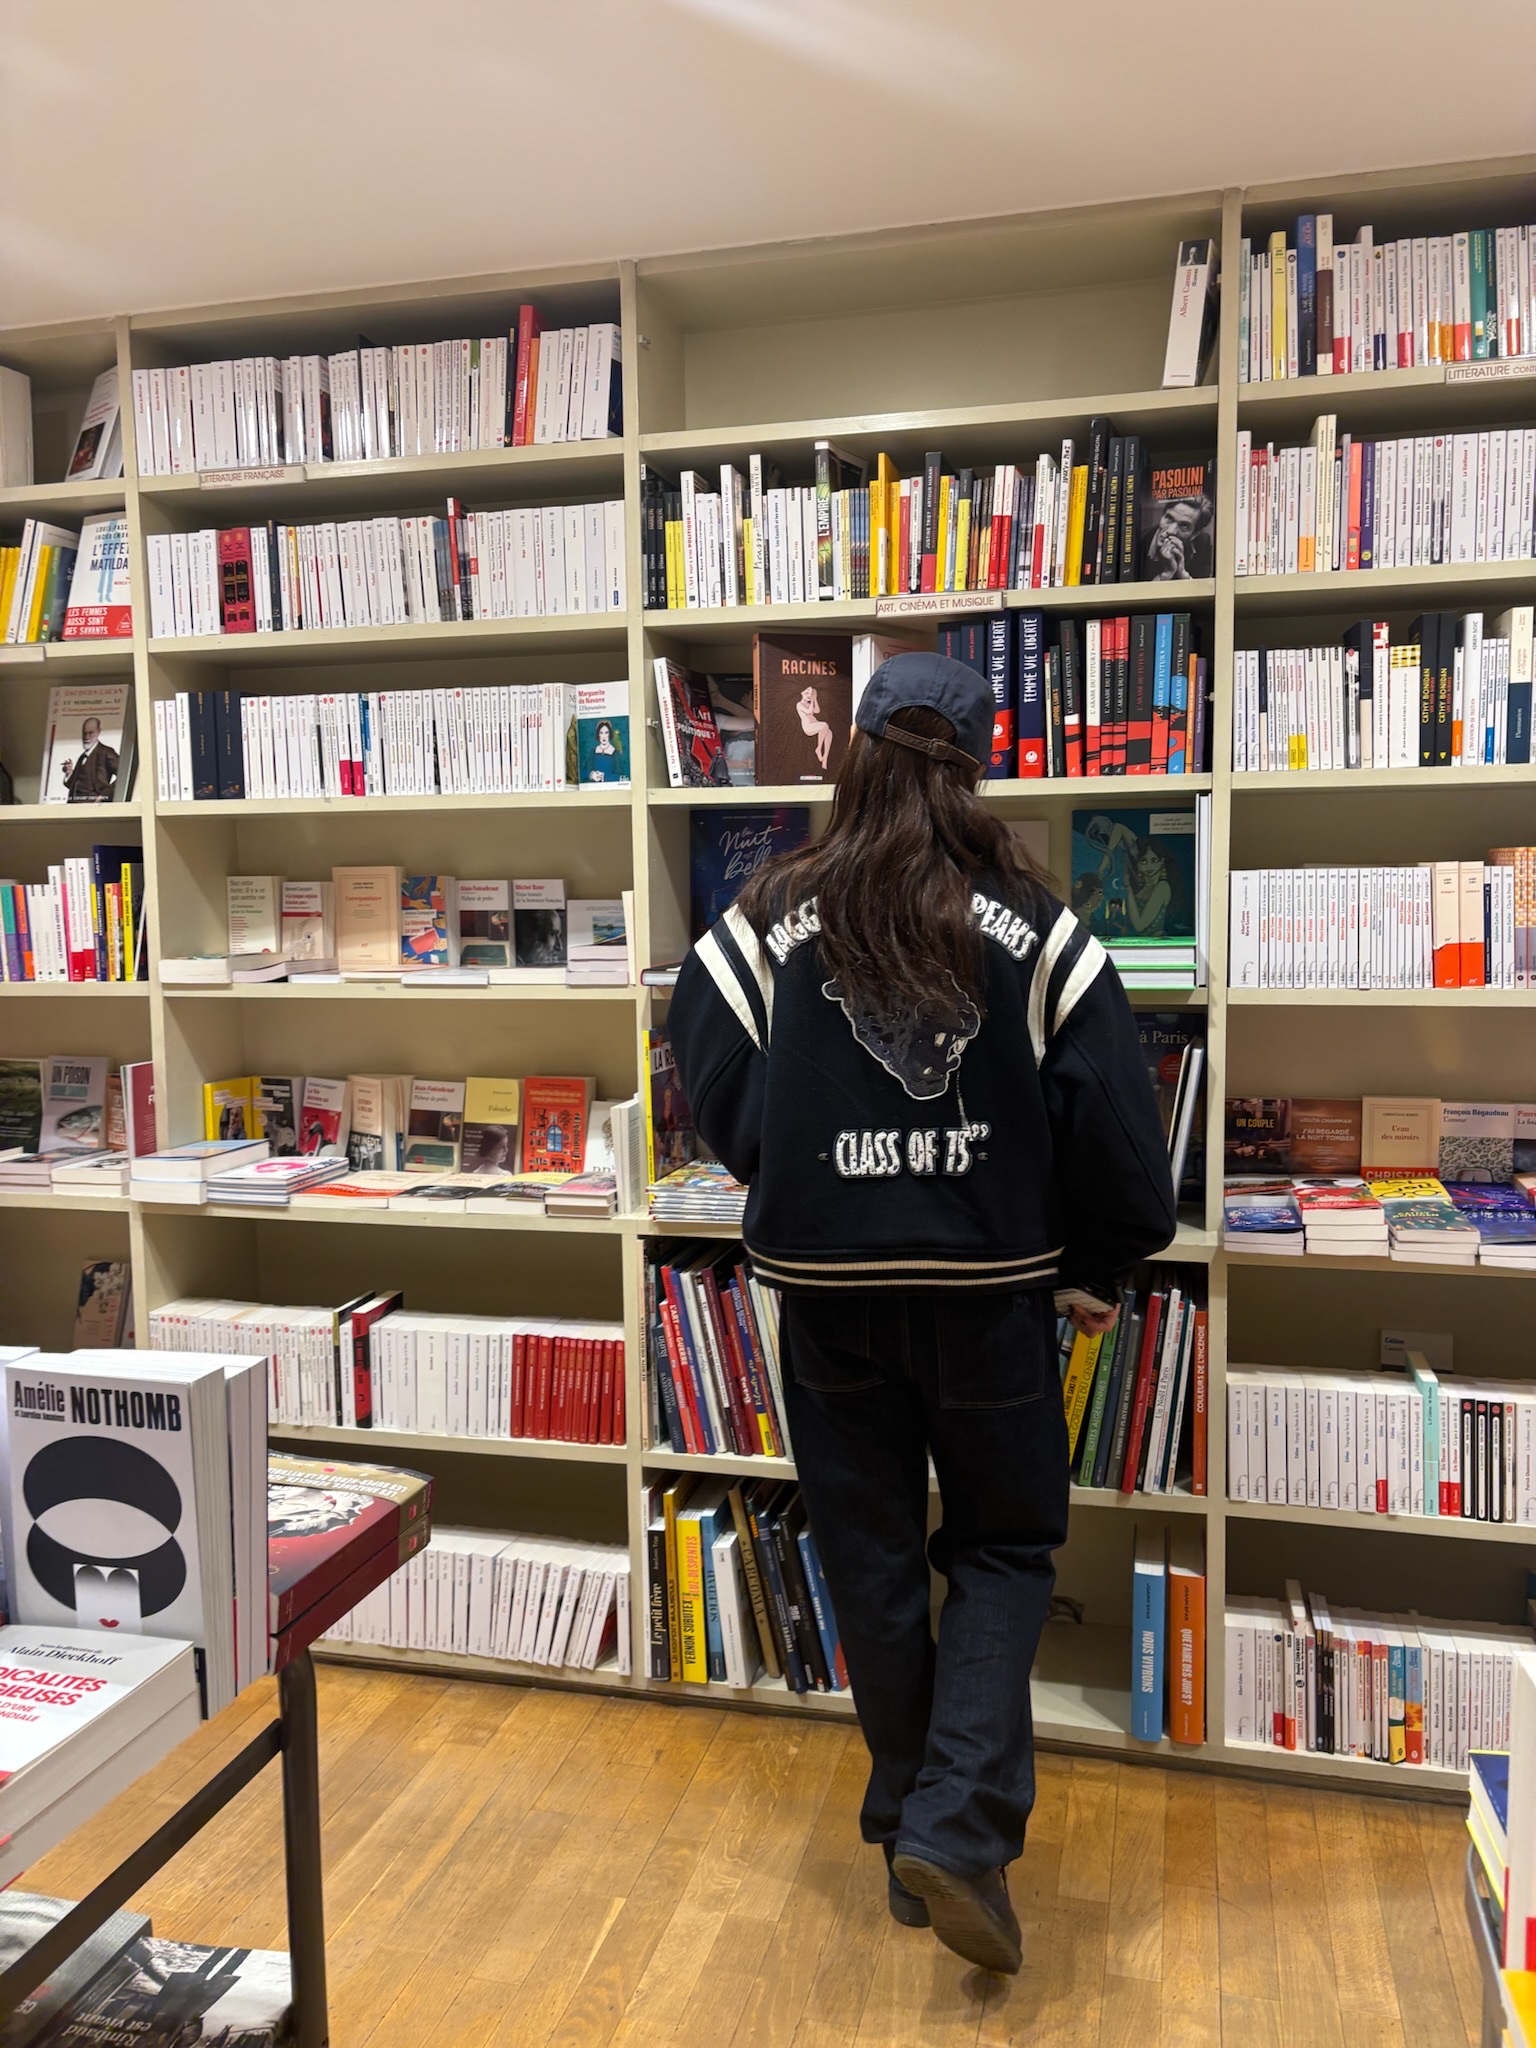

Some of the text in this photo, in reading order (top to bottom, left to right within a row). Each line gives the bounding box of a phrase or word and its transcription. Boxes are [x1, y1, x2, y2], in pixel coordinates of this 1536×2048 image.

[1448, 365, 1510, 380] LITTÉRATURE
[244, 469, 286, 480] FRANÇAISE
[1125, 475, 1134, 493] CINÉMA
[1151, 465, 1204, 489] PASOLINI
[1108, 476, 1117, 494] CINÉMA
[1151, 485, 1203, 499] PAR PASOLINI
[818, 497, 829, 536] L'EMPIRE
[1107, 527, 1115, 553] INVISIBLES
[90, 558, 128, 571] MATILDA
[878, 596, 994, 613] ART, CINÉMA ET MUSIQUE
[782, 659, 837, 676] RACINES
[991, 619, 1005, 703] FEMME VIE LIBERTÉ
[1023, 618, 1037, 702] FEMME VIE LIBERTÉ
[1439, 668, 1447, 699] BONIDAN
[677, 720, 711, 739] POLITIQUE
[719, 825, 783, 856] Nuit
[724, 845, 772, 880] bell
[1139, 1030, 1188, 1043] à Paris
[654, 1050, 663, 1070] LA
[1443, 1108, 1509, 1117] François Bégaudeau
[1236, 1119, 1274, 1128] UN COUPLE
[835, 1131, 900, 1176] CLASS
[908, 1130, 937, 1173] OF
[1366, 1171, 1434, 1179] CHRISTIAN
[659, 1335, 668, 1357] Rufin
[677, 1337, 688, 1366] GUERRE
[1160, 1366, 1169, 1382] Paris
[1196, 1325, 1205, 1413] COULEURS DE L'INCENDIE
[1067, 1384, 1076, 1394] SANS
[1068, 1347, 1098, 1444] LES GORILLES DU GÉNÉRAL
[1157, 1391, 1166, 1406] Noël
[14, 1381, 182, 1431] Amélie NOTHOMB
[1064, 1395, 1073, 1409] MONDE
[1087, 1380, 1106, 1451] SUITES ALGÉRIENNES
[1155, 1407, 1163, 1419] Un
[650, 1583, 664, 1607] frère
[706, 1570, 718, 1622] SOLEDAD
[790, 1605, 800, 1620] BUG
[682, 1600, 696, 1664] VERNON SUBUTEX
[1180, 1628, 1192, 1642] QUE
[9, 1646, 123, 1666] Alain Dieckhoff
[1141, 1630, 1154, 1694] NOUS VIVRONS
[1181, 1642, 1192, 1662] FAIRE
[1181, 1663, 1192, 1678] DES
[1181, 1679, 1192, 1700] JUIFS
[1, 1701, 36, 1712] D'UNE
[75, 2013, 152, 2032] est vivant
[61, 2025, 141, 2047] Rimbaud
